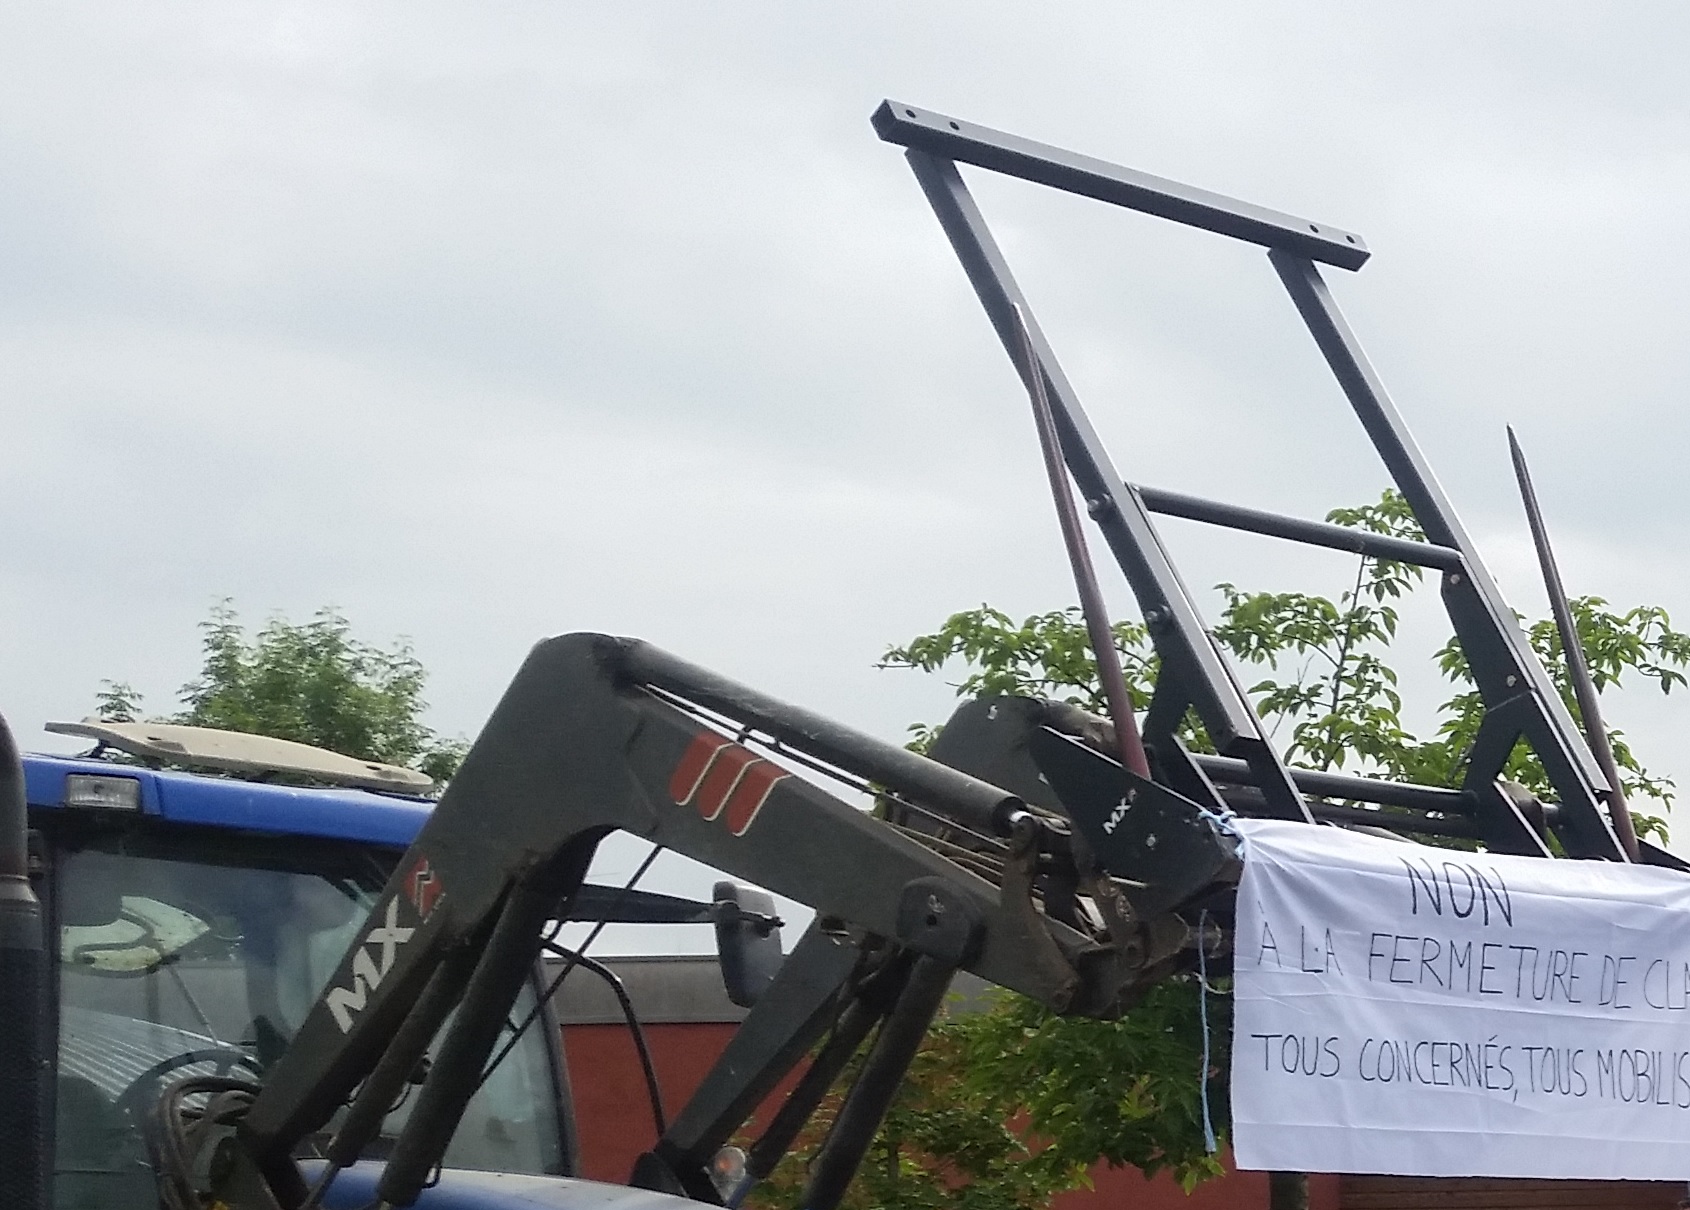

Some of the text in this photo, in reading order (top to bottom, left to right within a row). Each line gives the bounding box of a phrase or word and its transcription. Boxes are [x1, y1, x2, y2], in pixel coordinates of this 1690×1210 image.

[1103, 797, 1132, 836] MX
[1399, 857, 1513, 927] NON
[325, 895, 416, 1035] MX
[1369, 931, 1588, 1005] FERMETURE
[1598, 955, 1637, 1009] DE
[1250, 1034, 1341, 1079] TOUS
[1522, 1045, 1589, 1097] TOUS
